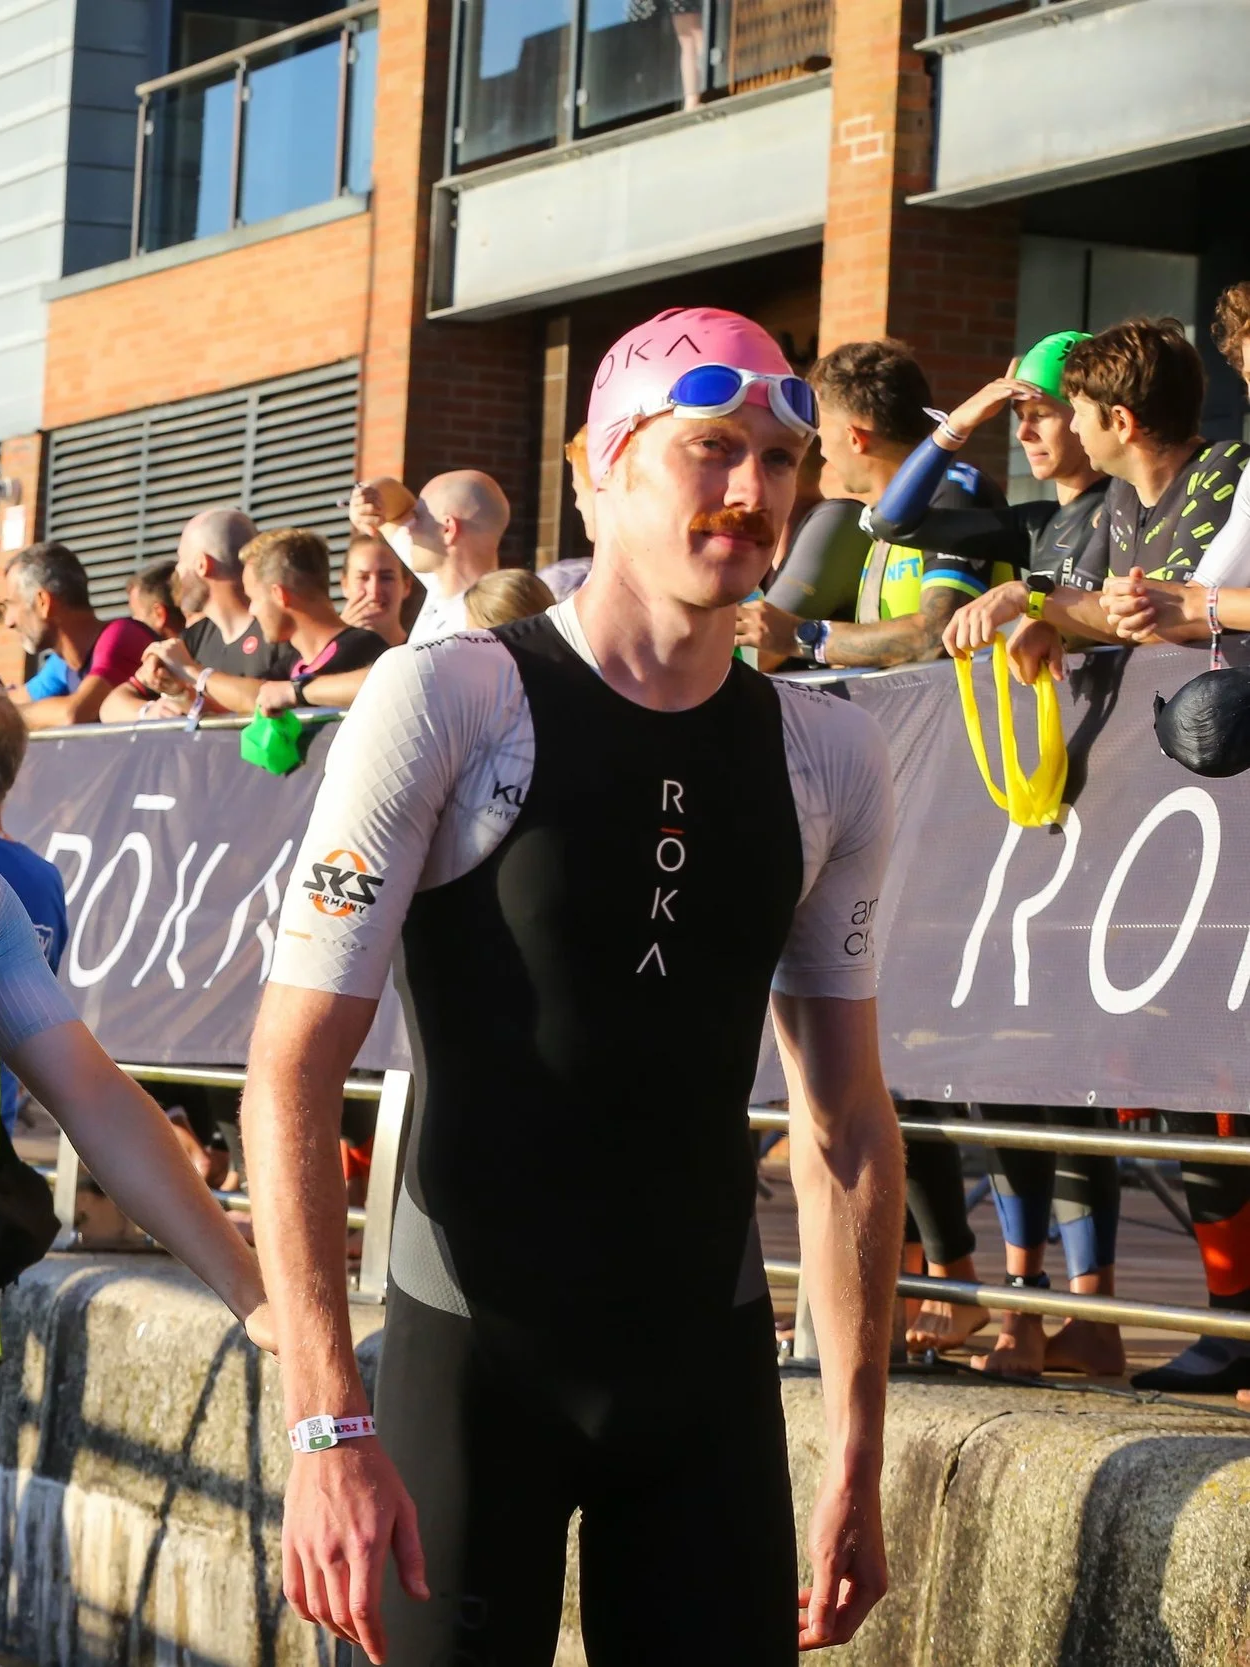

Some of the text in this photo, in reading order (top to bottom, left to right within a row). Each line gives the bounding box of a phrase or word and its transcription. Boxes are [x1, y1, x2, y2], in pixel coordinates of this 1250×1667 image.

[596, 333, 702, 390] OKA
[302, 862, 385, 905] SKS
[308, 892, 366, 914] GERMANY
